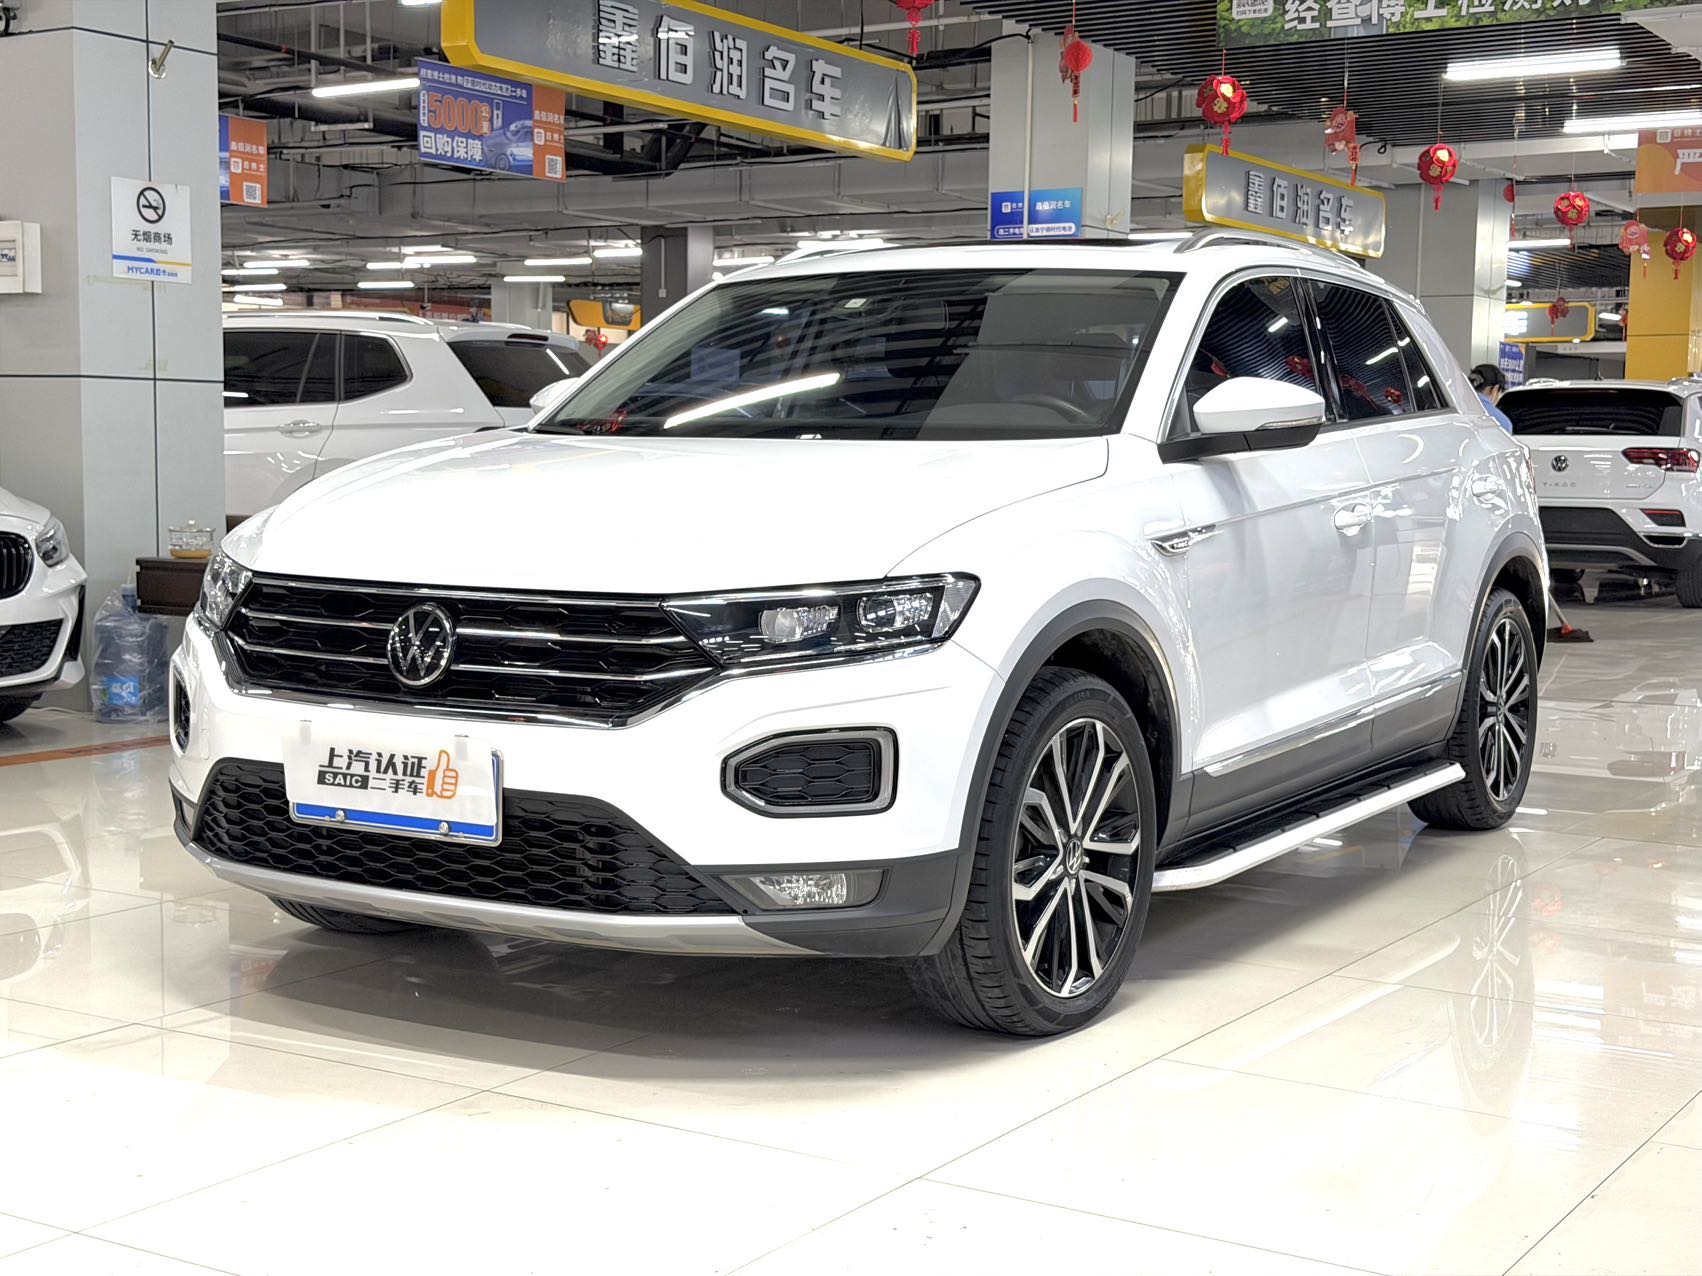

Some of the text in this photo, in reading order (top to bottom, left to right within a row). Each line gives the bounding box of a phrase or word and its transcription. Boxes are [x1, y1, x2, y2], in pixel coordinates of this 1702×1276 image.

[597, 0, 842, 120] 鑫佰润名车
[429, 92, 483, 136] 5000
[420, 131, 483, 162] 回购保障
[1246, 170, 1354, 236] 鑫佰润名车
[131, 229, 173, 246] 无烟商场
[318, 746, 428, 779] 上汽认证
[324, 772, 363, 787] SAIC
[369, 776, 425, 796] 二手车
